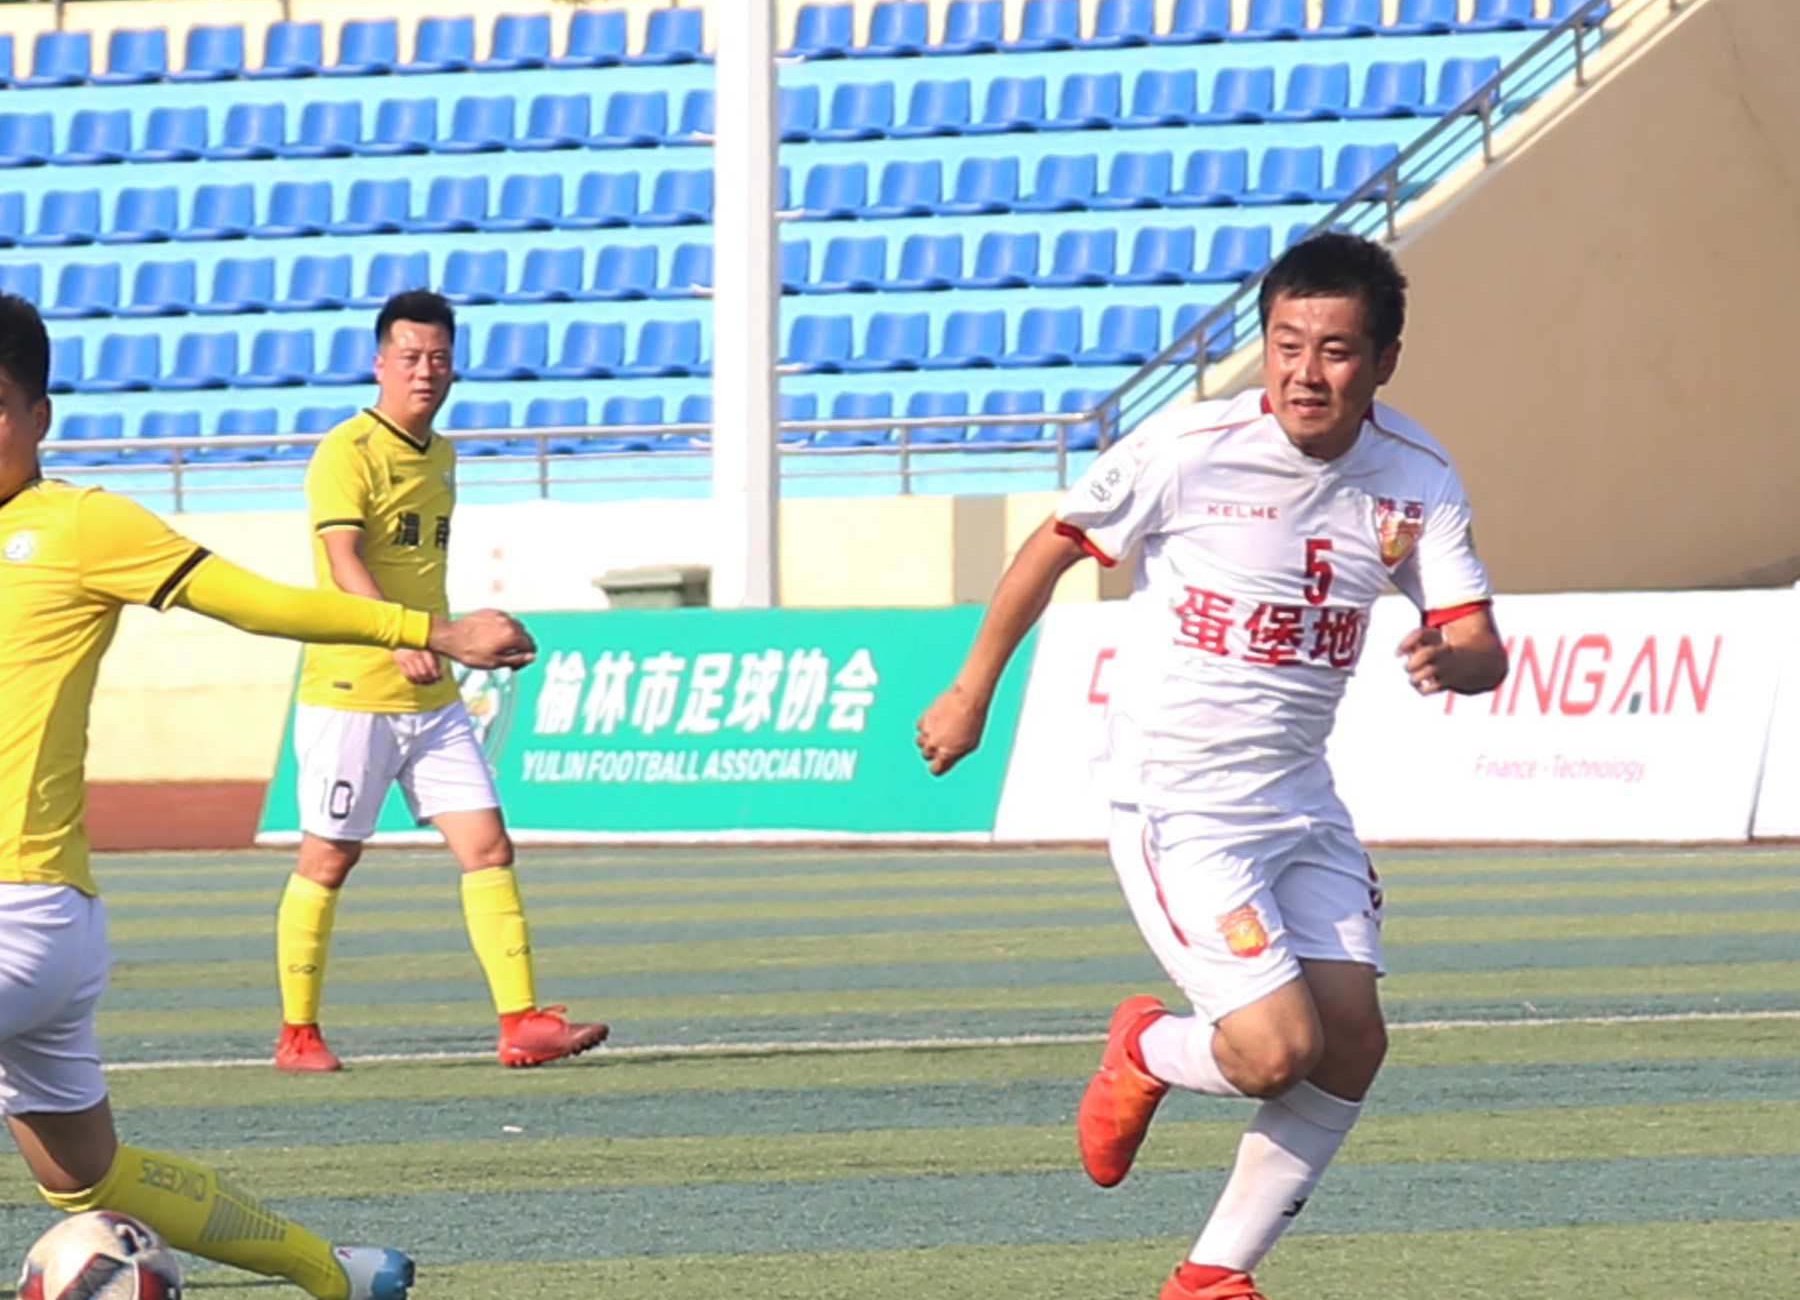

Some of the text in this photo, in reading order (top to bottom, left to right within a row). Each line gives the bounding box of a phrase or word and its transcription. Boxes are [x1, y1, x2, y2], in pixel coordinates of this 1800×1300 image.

[1207, 502, 1280, 521] KELME
[1302, 538, 1333, 606] 5
[1172, 584, 1368, 668] 蛋堡地
[532, 646, 880, 736] 榆林市足球协会
[521, 747, 858, 784] YULIN FOOTBALL ASSOCIATION
[1473, 754, 1538, 780] Finance
[1551, 753, 1647, 783] Technology
[319, 777, 355, 821] 10
